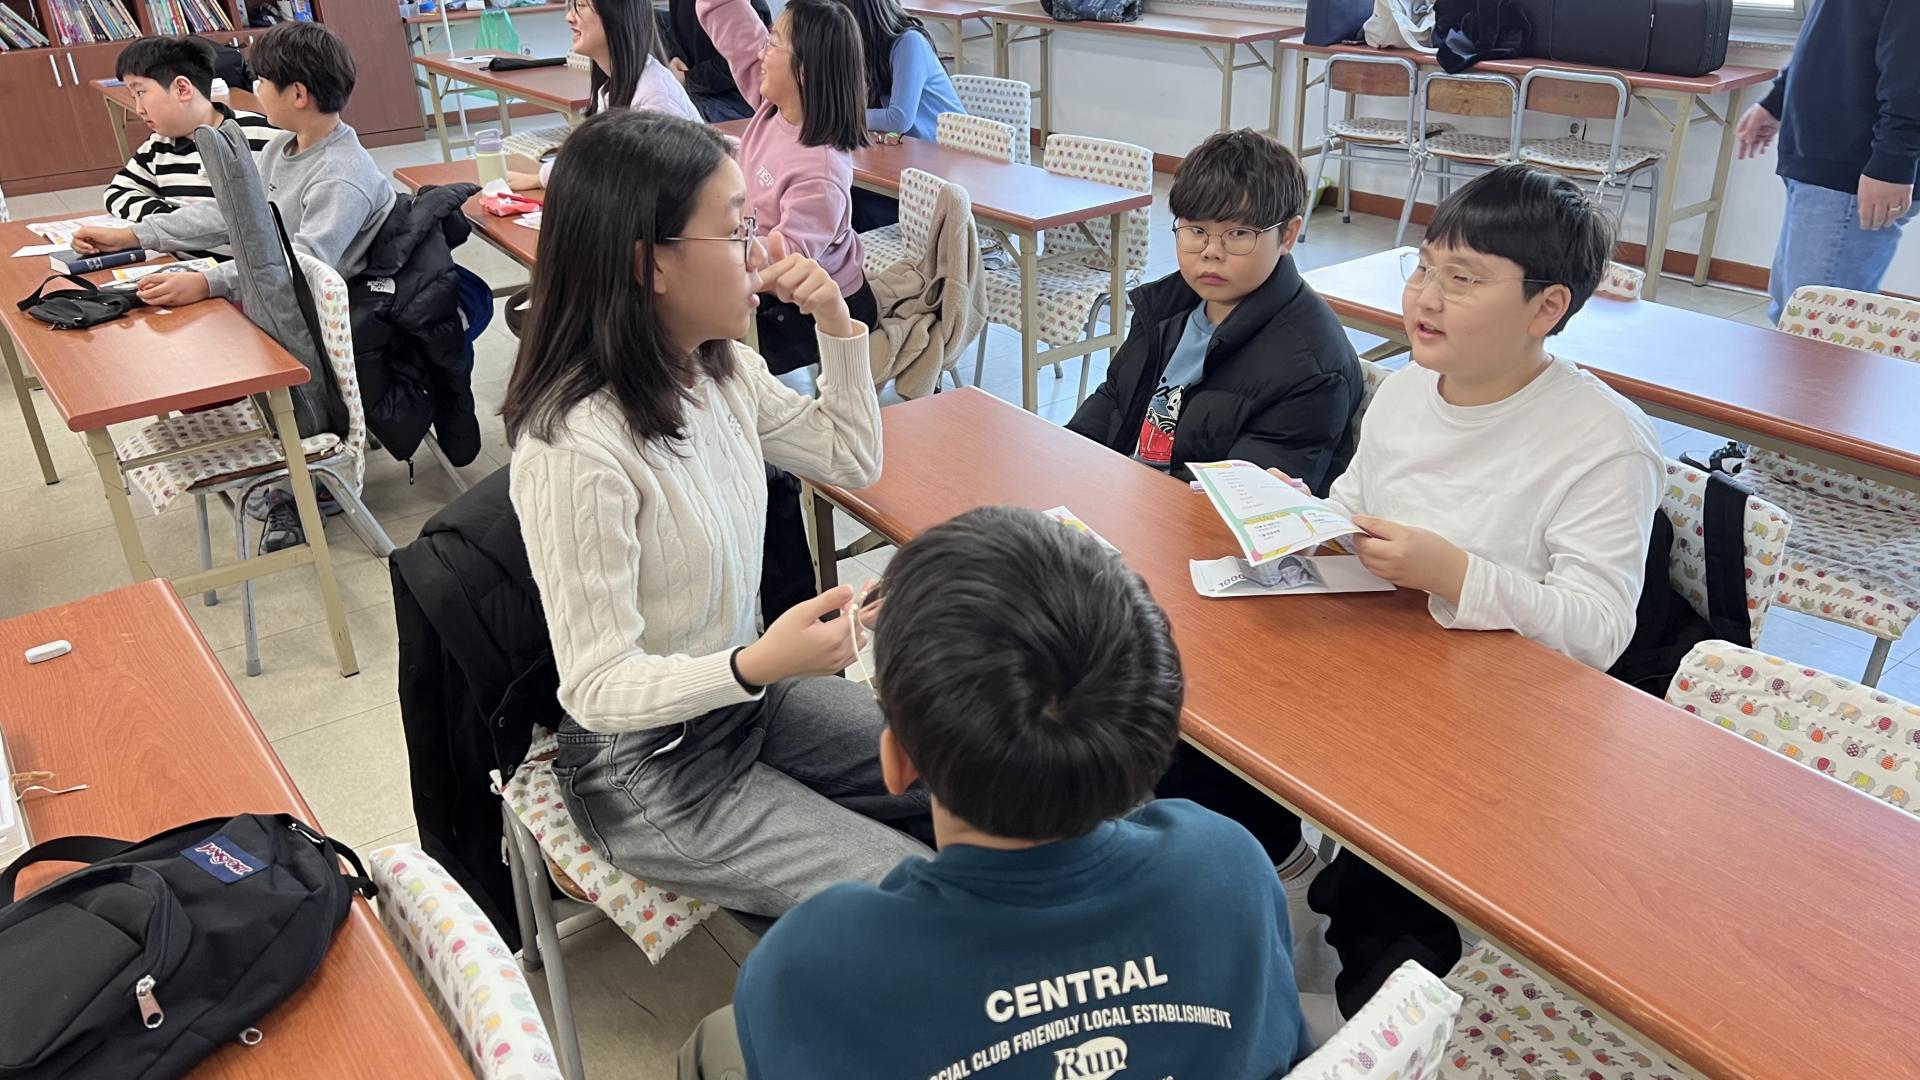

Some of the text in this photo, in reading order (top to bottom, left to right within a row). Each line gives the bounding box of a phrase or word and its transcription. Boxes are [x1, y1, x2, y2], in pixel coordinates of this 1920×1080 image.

[985, 956, 1169, 1023] CENTRAL
[929, 1004, 1232, 1080] CIAL CLUB FRIENDLY LOCAL ESTABLISHMENT
